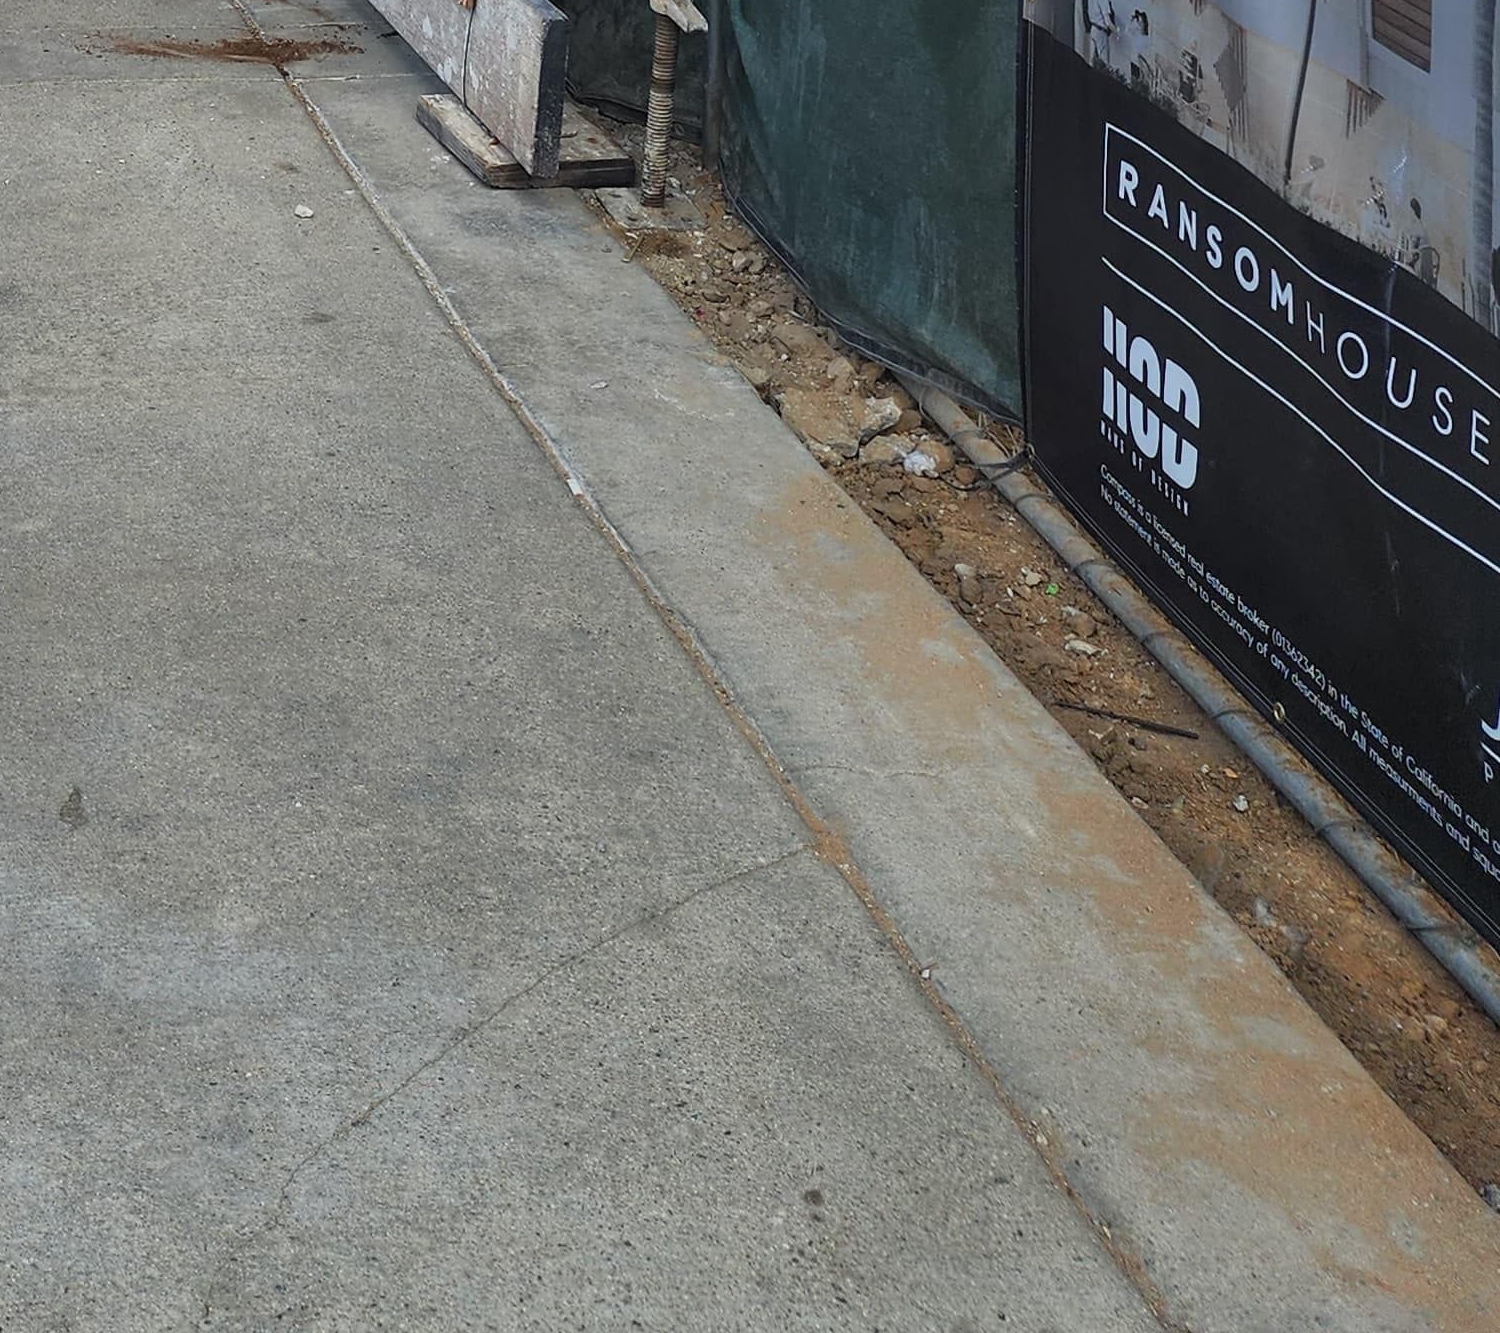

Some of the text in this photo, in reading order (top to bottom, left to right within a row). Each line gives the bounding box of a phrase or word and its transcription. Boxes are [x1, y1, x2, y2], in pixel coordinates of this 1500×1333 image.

[1118, 159, 1491, 465] RANSOMHOUSE
[1131, 450, 1143, 473] OF
[1161, 548, 1186, 581] made
[1210, 599, 1254, 648] accuracy
[1256, 641, 1269, 659] of
[1270, 653, 1290, 680] any
[1351, 729, 1367, 754] All
[1445, 821, 1471, 853] and
[1187, 553, 1204, 578] real
[1205, 572, 1236, 605] estate
[1237, 595, 1270, 635] broker
[1340, 693, 1359, 719] the
[1360, 710, 1389, 750] State
[1391, 744, 1403, 763] of
[1405, 754, 1462, 819] California
[1465, 813, 1490, 845] and
